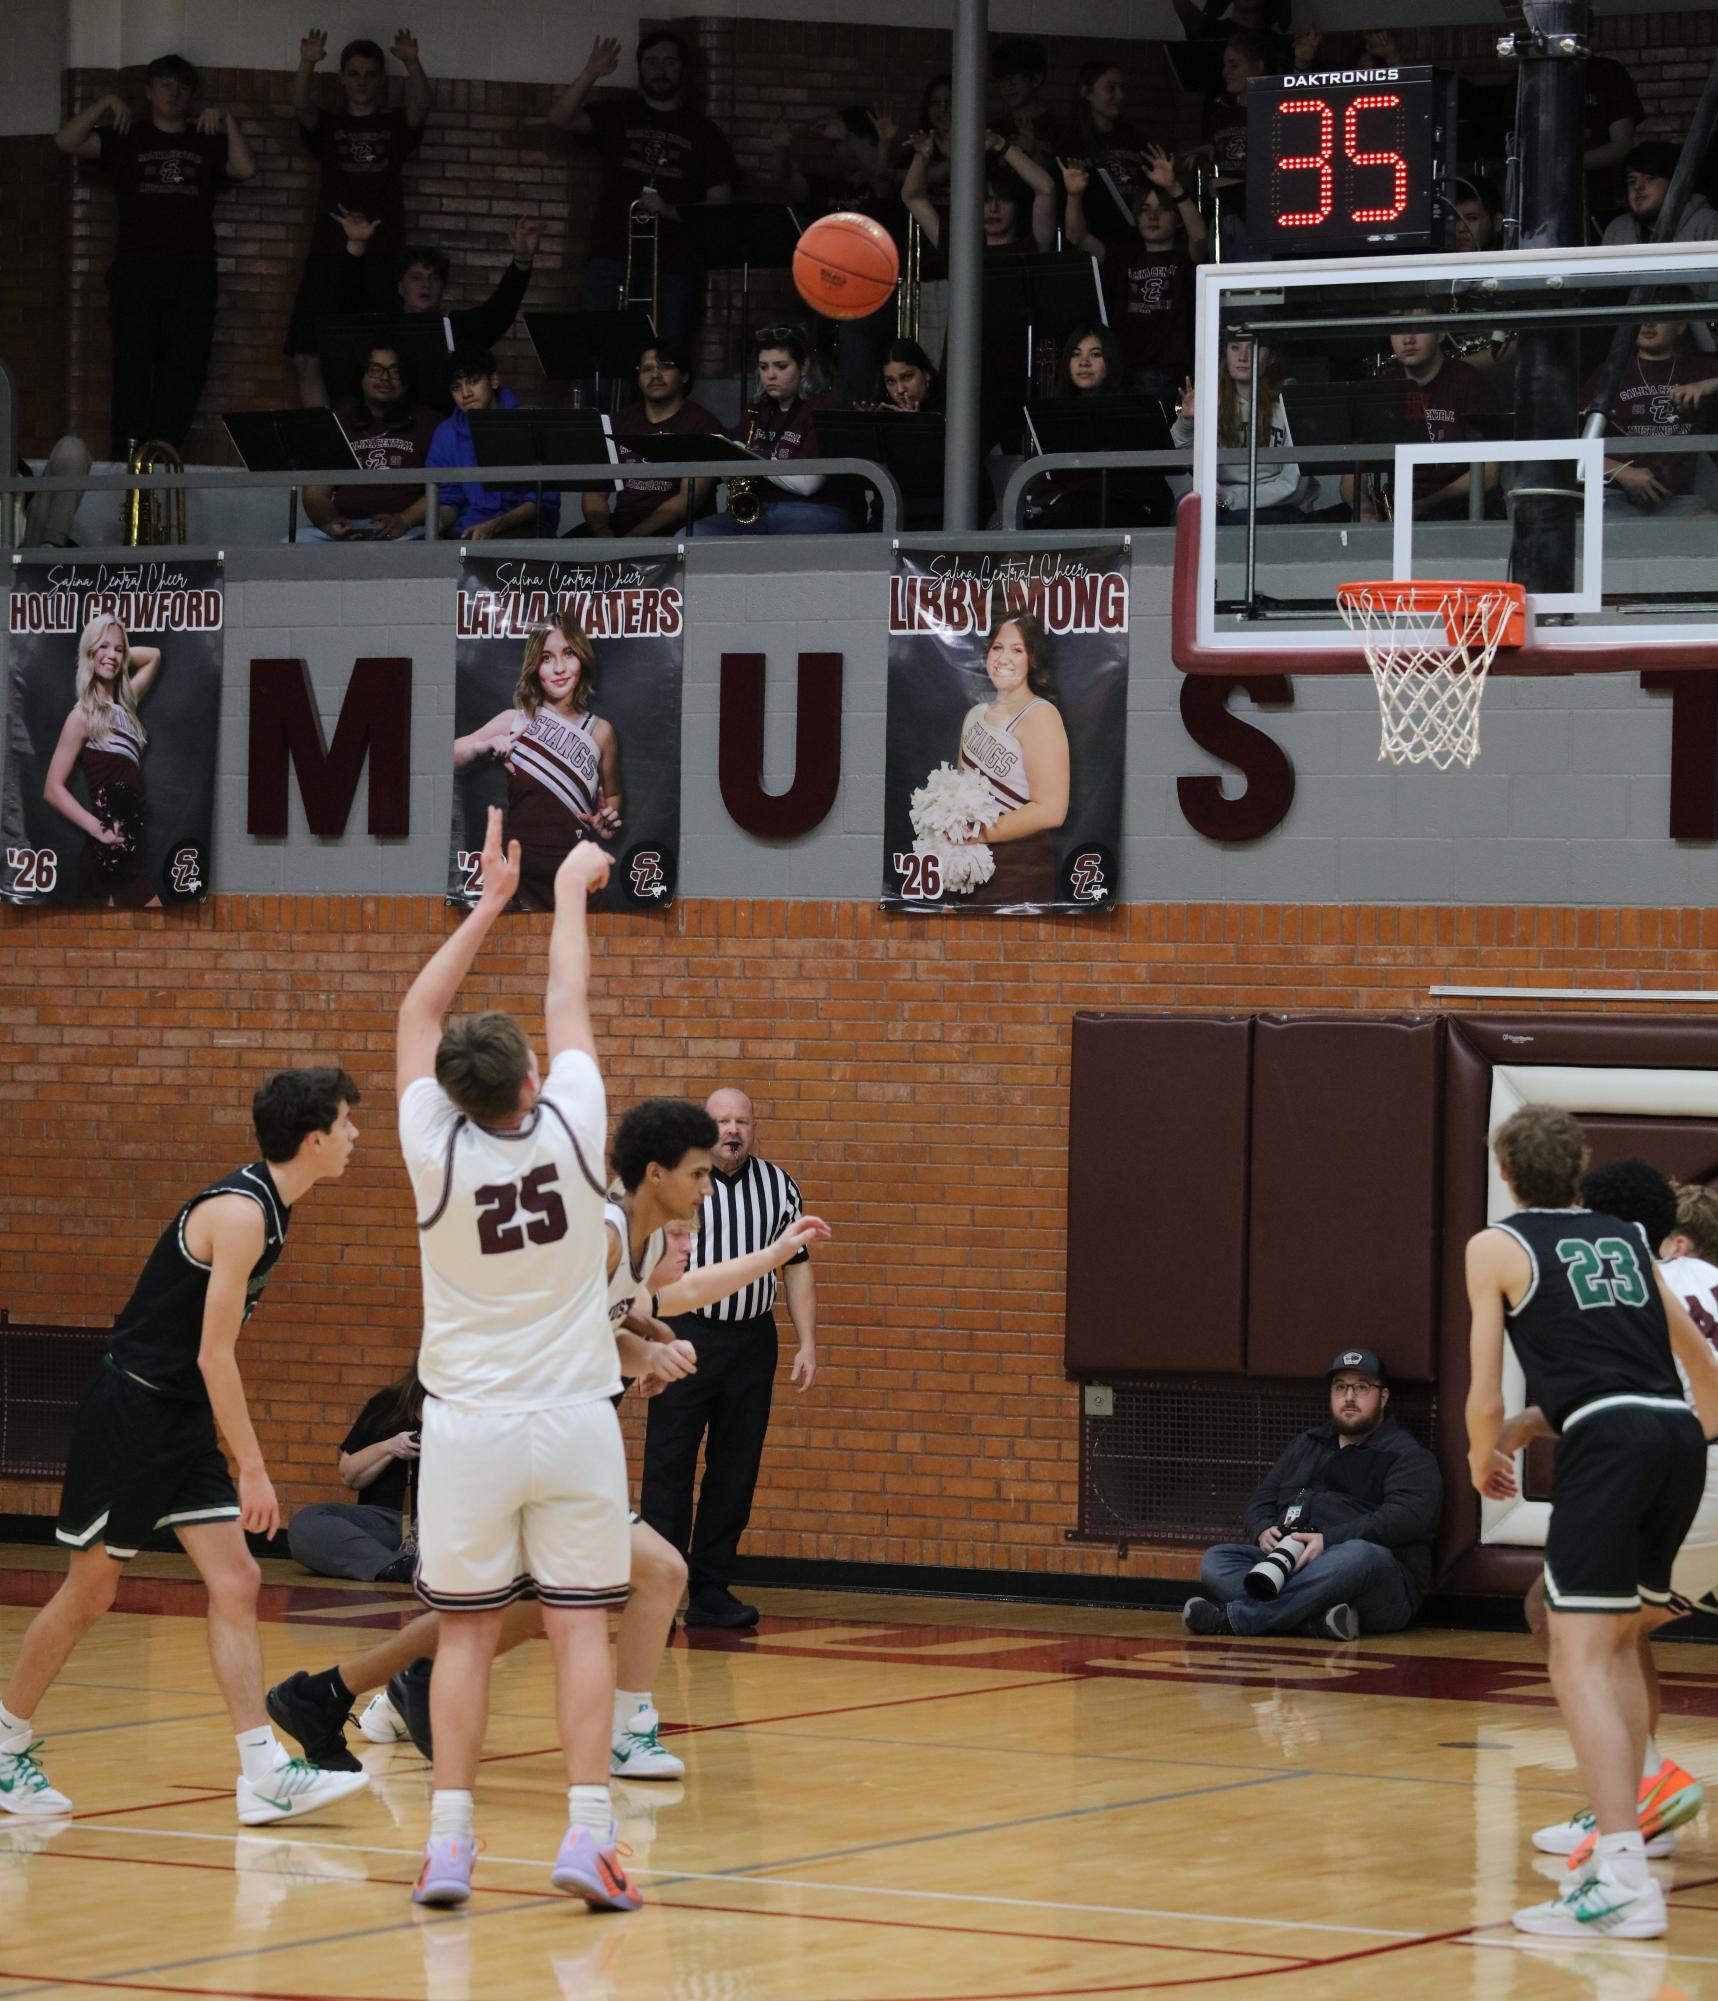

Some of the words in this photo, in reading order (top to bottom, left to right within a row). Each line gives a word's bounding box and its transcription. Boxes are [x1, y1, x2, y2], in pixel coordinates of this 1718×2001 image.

[1283, 69, 1399, 88] DAKTRONICS
[1277, 94, 1408, 227] 35
[47, 564, 94, 600] Salina
[95, 563, 144, 601] Central
[146, 562, 188, 595] Cheer
[495, 562, 544, 598] Salina
[548, 561, 598, 598] Central
[603, 562, 646, 595] Cheer
[928, 554, 977, 592] Salina
[980, 555, 1034, 593] Central
[1039, 553, 1089, 588] Cheer
[9, 592, 79, 634] HOLLI
[456, 590, 552, 639] LAYLA
[889, 575, 994, 637] LIBBY
[526, 714, 598, 781] STANGS
[6, 848, 58, 893] '26
[893, 852, 945, 901] '26
[474, 1162, 569, 1256] 25
[1555, 1237, 1651, 1311] 23
